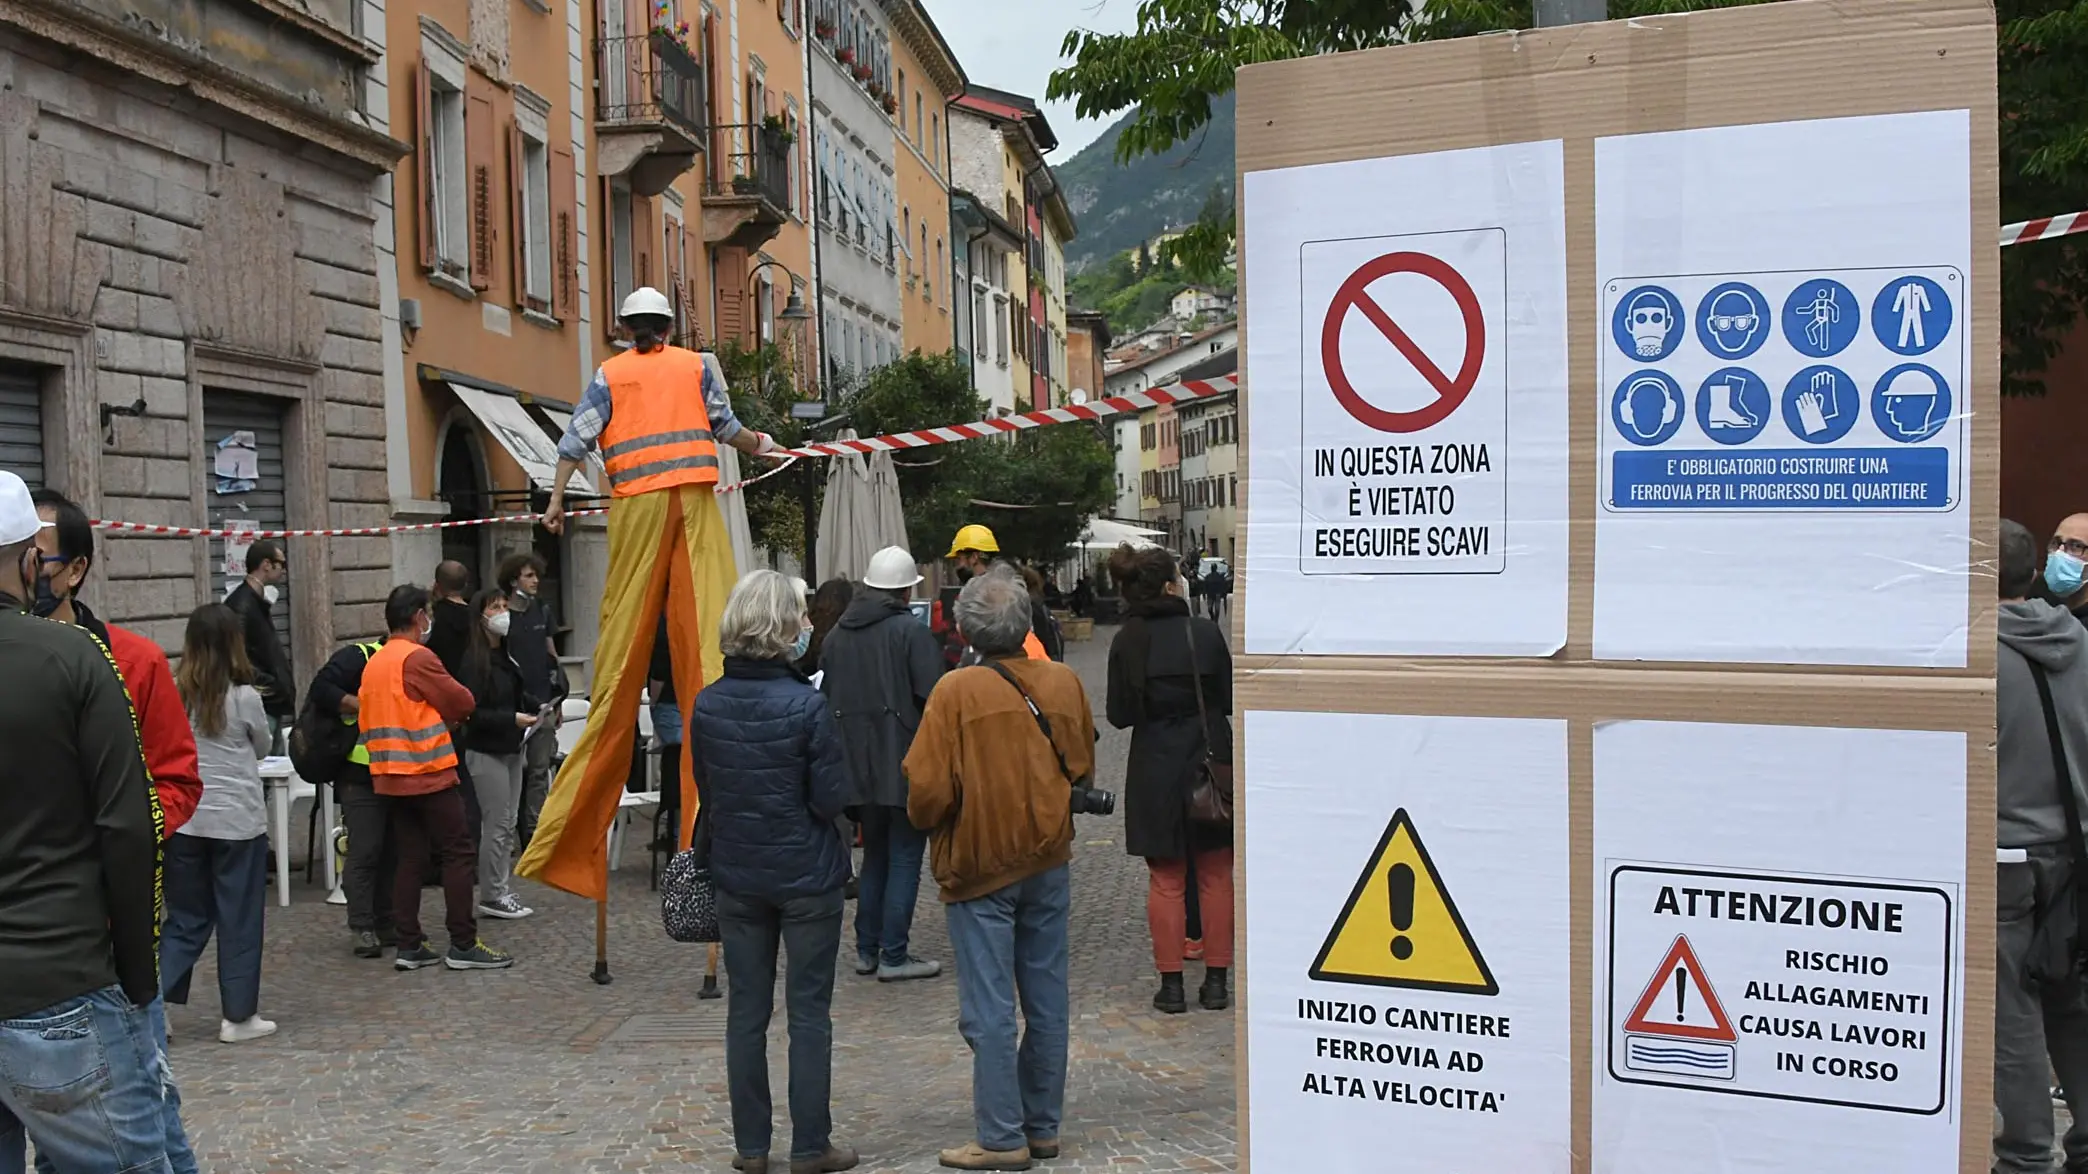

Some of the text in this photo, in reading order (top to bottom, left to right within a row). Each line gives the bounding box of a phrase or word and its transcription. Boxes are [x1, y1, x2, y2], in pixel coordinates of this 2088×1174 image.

[1315, 443, 1491, 478] IN QUESTA ZONA
[1667, 457, 1889, 476] E' OBBLIGATORIO COSTRUIRE UNA
[1349, 482, 1454, 516] È VIETATO
[1630, 482, 1929, 502] FERROVIA PER IL PROGRESSO DEL QUARTIERE
[1315, 526, 1489, 557] ESEGUIRE SCAVI
[1653, 885, 1904, 934] ATTENZIONE
[1785, 949, 1889, 976] RISCHIO
[1744, 981, 1929, 1016] ALLAGAMENTI
[1298, 998, 1511, 1038] INIZIO CANTIERE
[1739, 1014, 1926, 1050] CAUSA LAVORI
[1316, 1037, 1484, 1073] FERROVIA AD
[1776, 1052, 1899, 1082] IN CORSO
[1302, 1073, 1505, 1113] ALTA VELOCITA'
